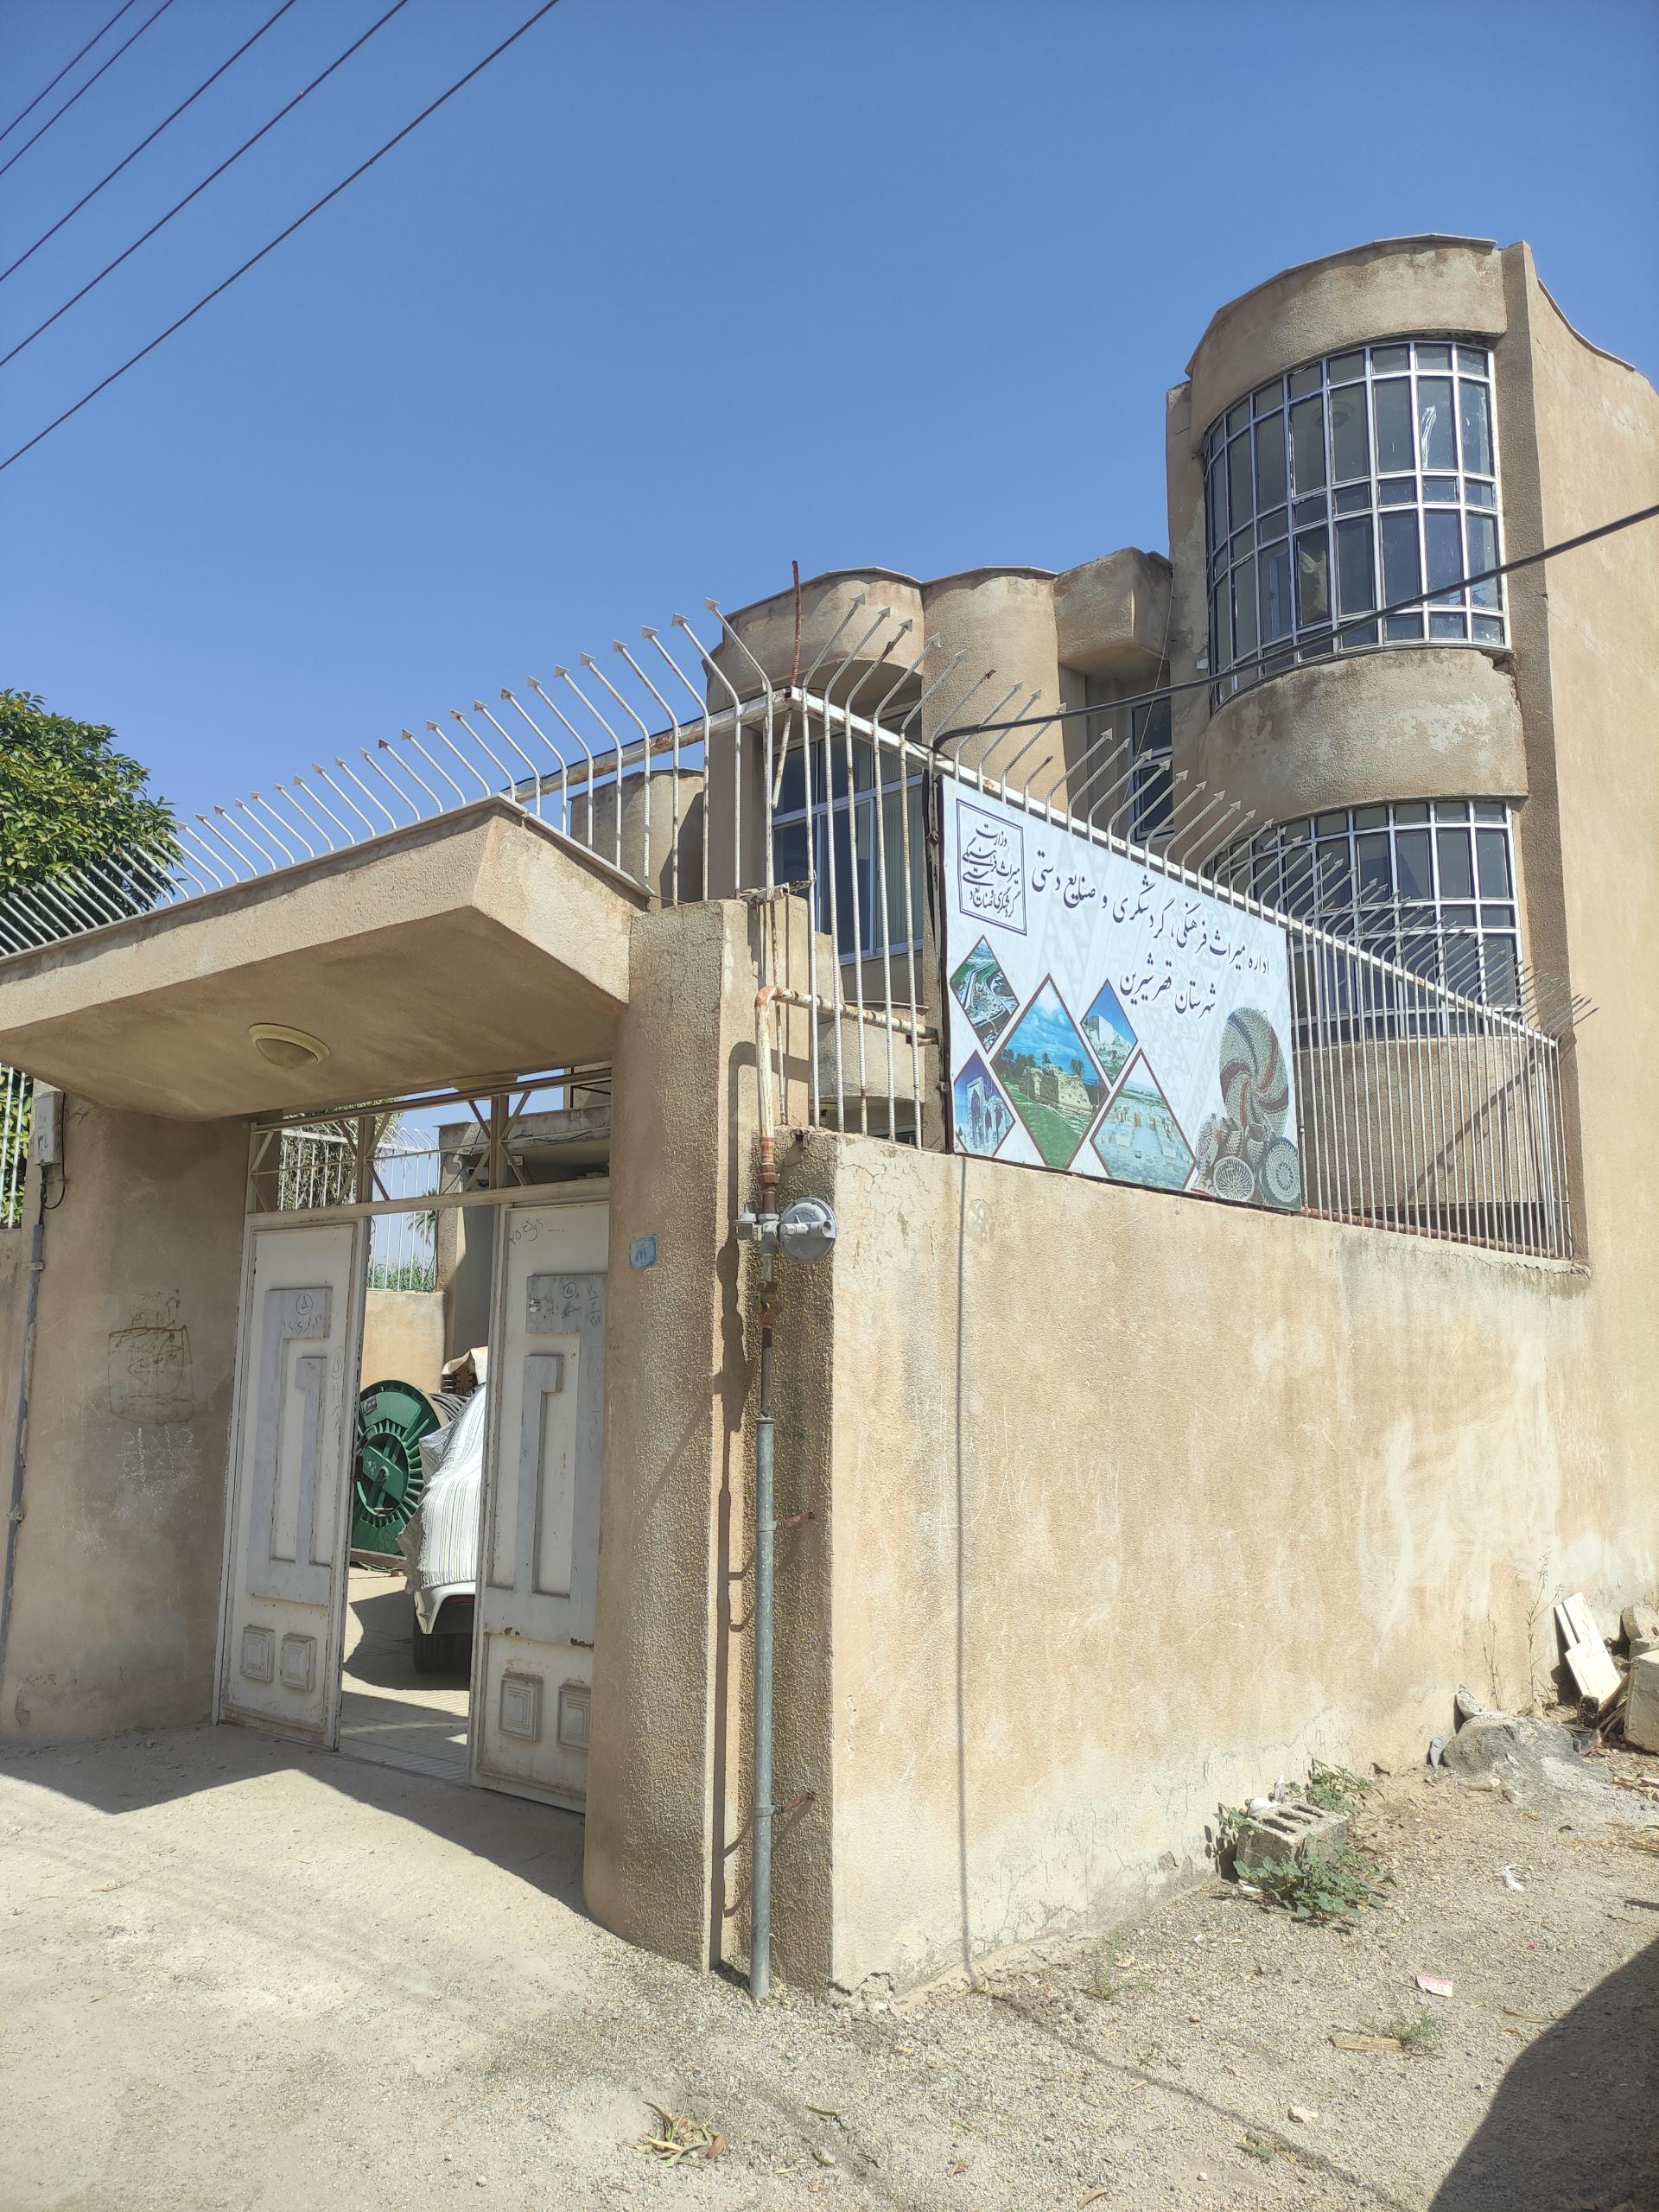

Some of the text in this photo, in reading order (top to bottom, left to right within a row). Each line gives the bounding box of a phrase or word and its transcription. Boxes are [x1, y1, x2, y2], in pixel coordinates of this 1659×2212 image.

[976, 823, 1007, 847] وزارت
[995, 861, 1020, 885] میراث
[1031, 849, 1061, 893] دستی
[1063, 873, 1096, 909] صنایع
[1101, 894, 1108, 909] و
[1112, 874, 1176, 938] گردشگری
[1209, 929, 1246, 970] میراث
[1248, 953, 1270, 974] اداره
[1119, 952, 1216, 1020] شهرستان قصر شیرین
